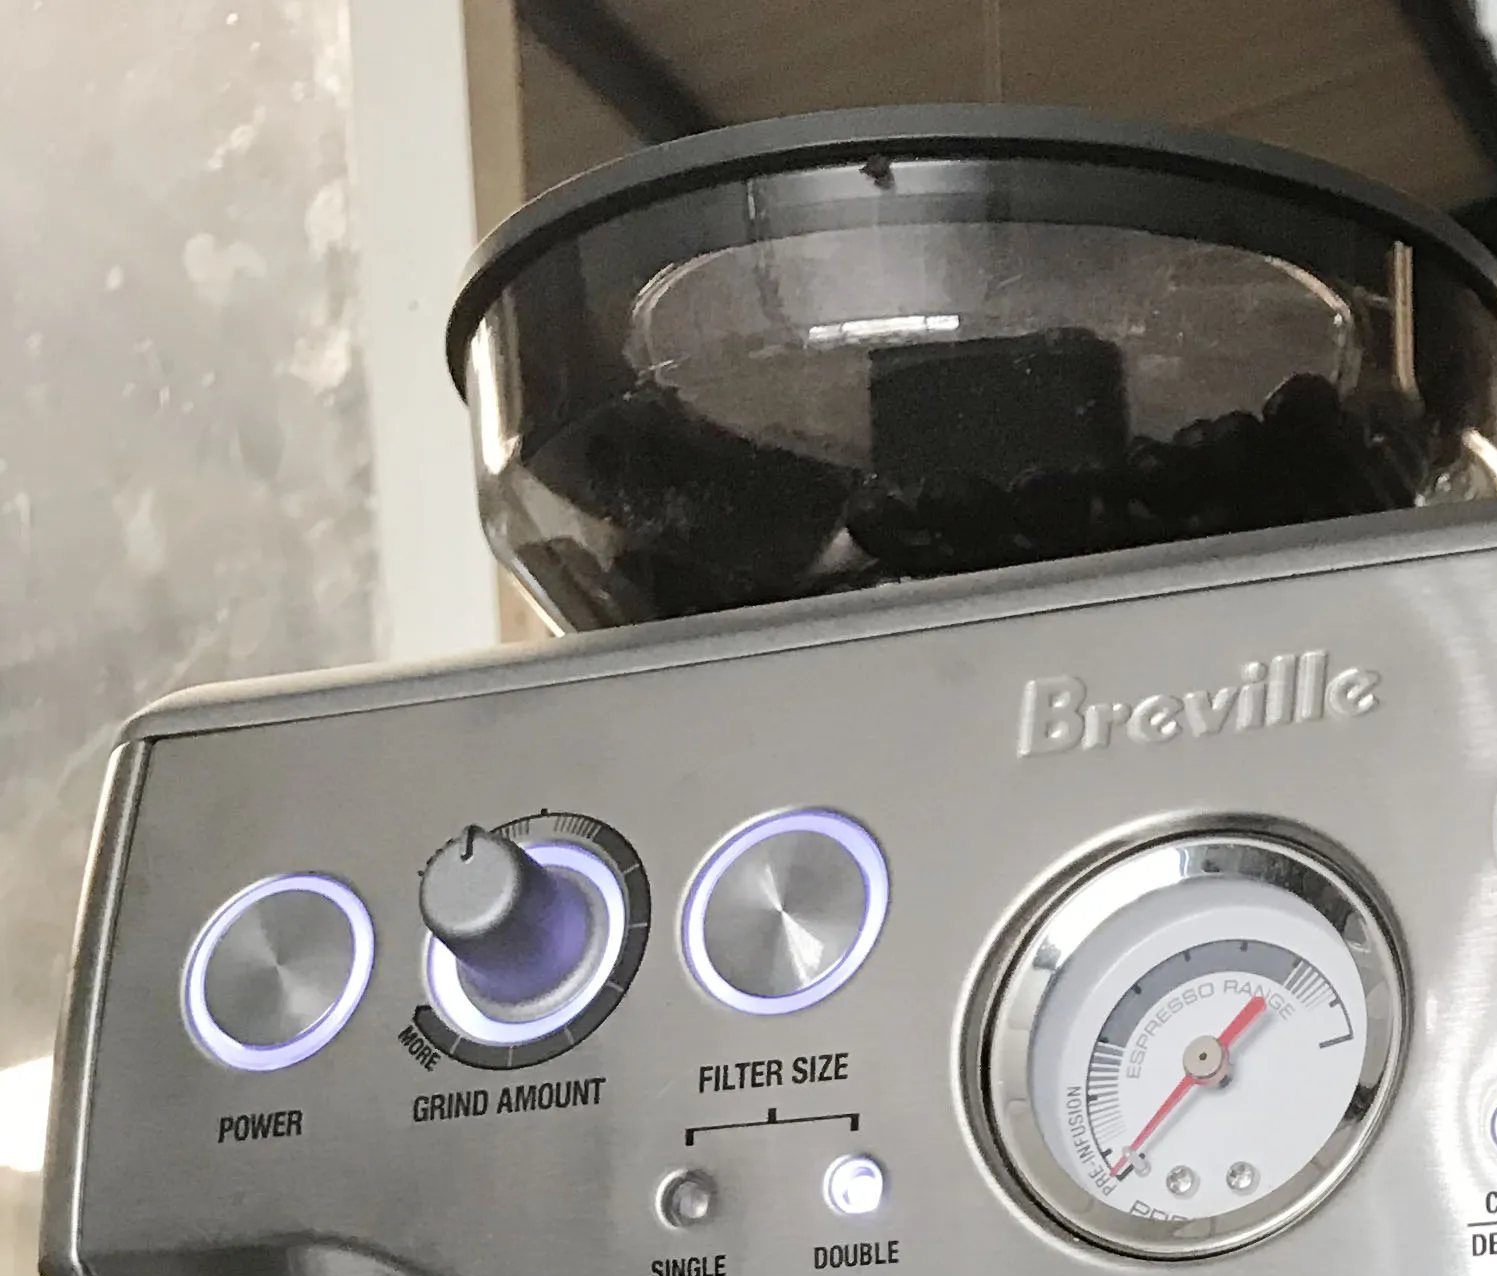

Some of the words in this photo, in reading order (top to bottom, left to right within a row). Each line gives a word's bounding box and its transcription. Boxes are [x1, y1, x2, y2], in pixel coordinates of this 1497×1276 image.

[1016, 649, 1382, 758] Breville
[397, 1025, 442, 1072] MORE
[1127, 982, 1215, 1079] ESPRESSO
[1223, 979, 1296, 1020] RANGE
[699, 1059, 783, 1093] FILTER
[791, 1052, 849, 1084] SIZE
[413, 1089, 489, 1122] GRIND
[496, 1077, 606, 1114] AMOUNT
[217, 1110, 302, 1143] POWER
[1066, 1086, 1117, 1196] PRE-INFUSION
[814, 1240, 899, 1270] DOUBLE
